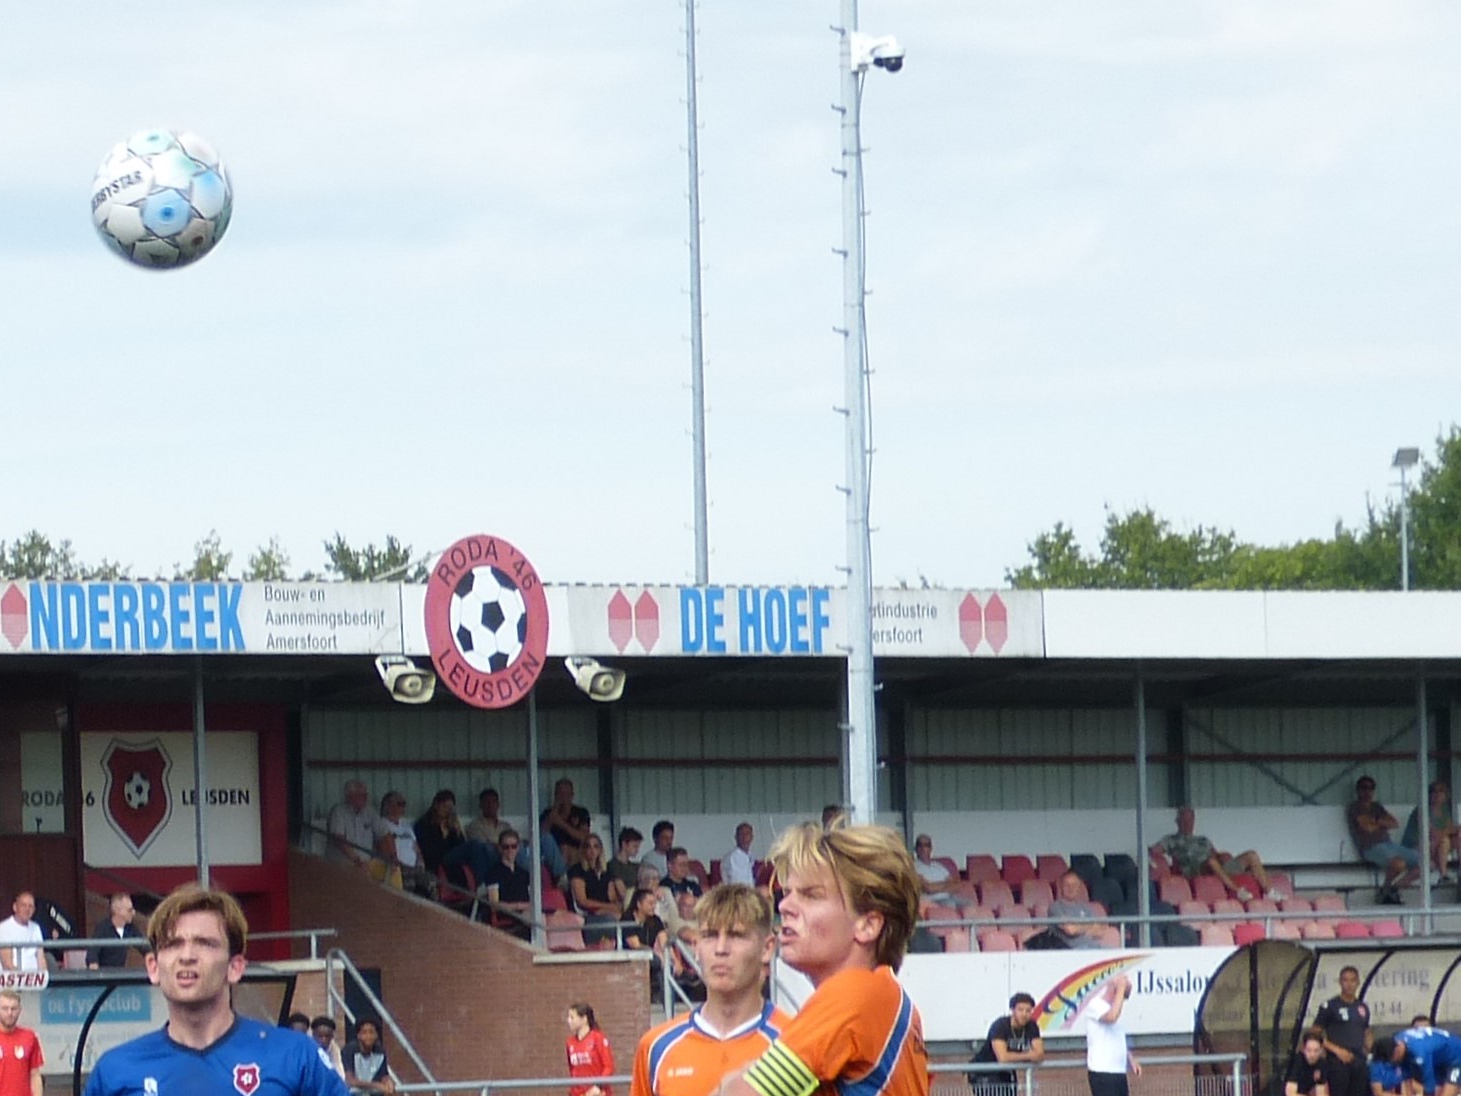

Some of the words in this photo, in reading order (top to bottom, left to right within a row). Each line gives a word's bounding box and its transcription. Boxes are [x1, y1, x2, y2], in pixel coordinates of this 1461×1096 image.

[437, 539, 499, 587] RODA
[509, 547, 538, 591] '46
[264, 585, 305, 601] Bouw-
[309, 588, 326, 602] en
[265, 608, 386, 630] Aannemingsbedrijf
[679, 587, 727, 654] DE
[739, 587, 830, 654] HOEF
[266, 632, 338, 650] Amersfoort
[872, 626, 923, 645] ersfoort
[438, 647, 541, 703] LEUSDEN
